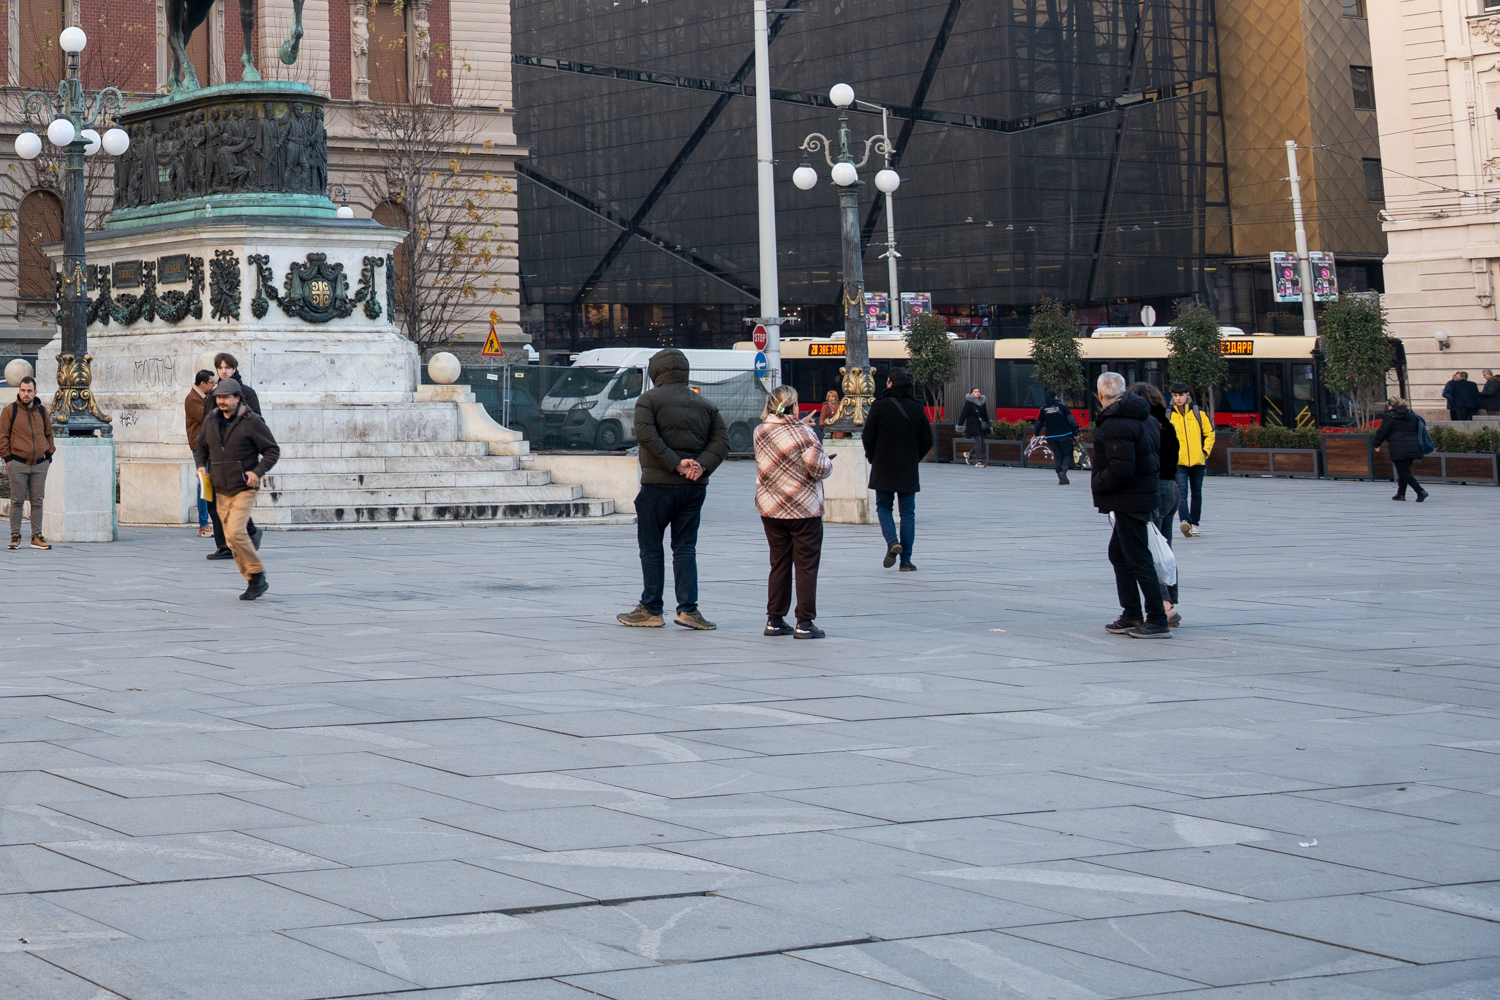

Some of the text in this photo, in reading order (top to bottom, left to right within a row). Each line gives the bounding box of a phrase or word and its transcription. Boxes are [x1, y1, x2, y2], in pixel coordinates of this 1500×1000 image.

[754, 333, 766, 343] STOP
[818, 344, 846, 355] ЗВЕЗДАР
[1220, 341, 1253, 354] ЕЗДАРА
